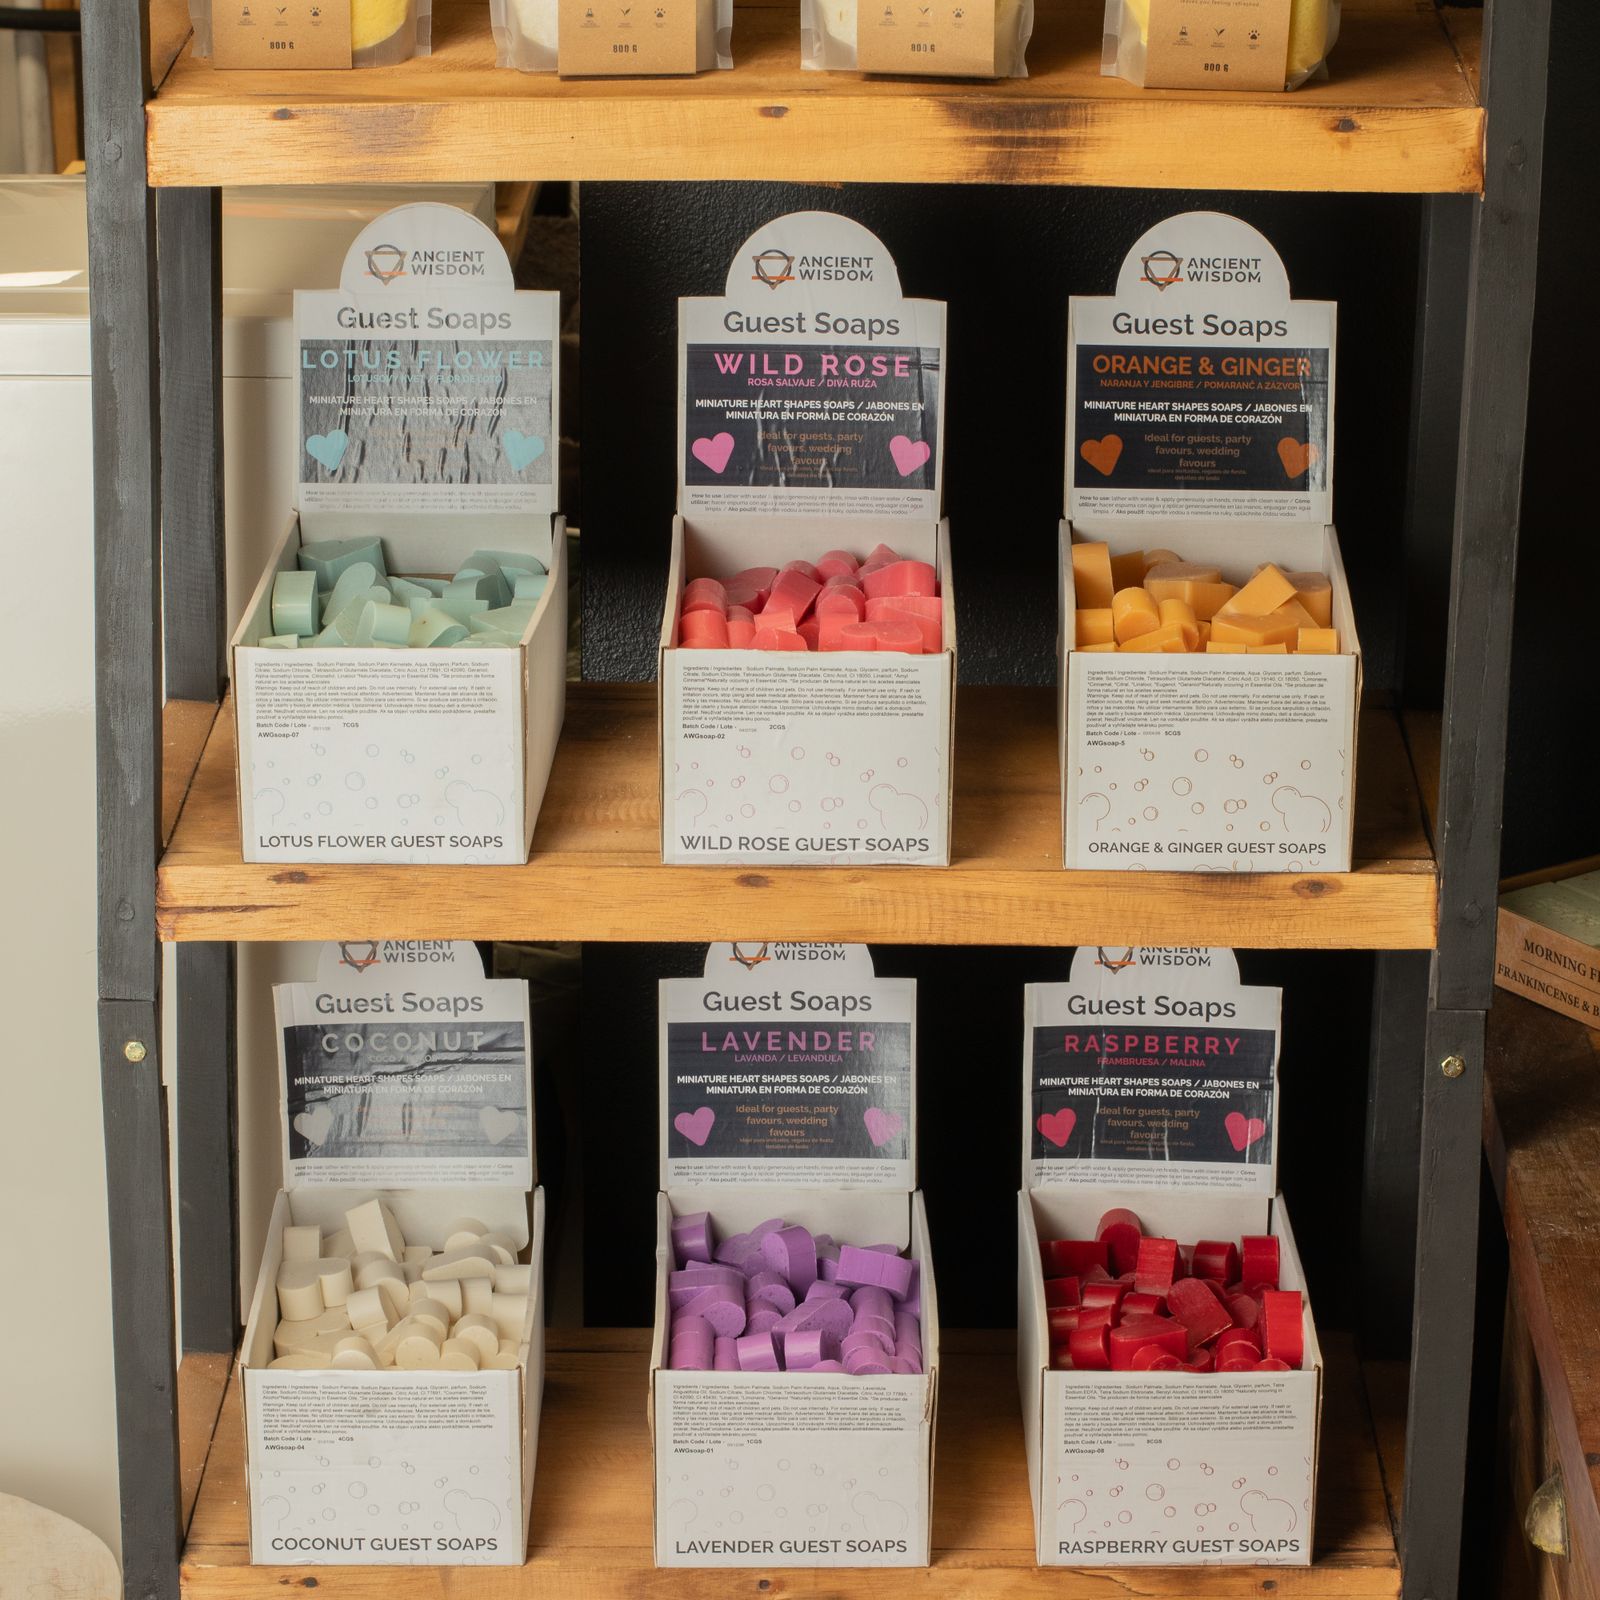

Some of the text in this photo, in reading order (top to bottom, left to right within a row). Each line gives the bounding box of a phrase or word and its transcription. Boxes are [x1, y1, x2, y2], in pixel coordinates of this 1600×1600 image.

[412, 251, 485, 262] ANCIENT
[799, 256, 873, 268] ANCIENT
[412, 264, 485, 276] WISDOM
[1187, 258, 1261, 270] ANCIENT
[799, 269, 873, 282] WISDOM
[1187, 271, 1261, 283] WISDOM
[337, 307, 511, 335] Guest Soaps
[724, 311, 899, 340] Guest Soaps
[1113, 313, 1287, 342] Guest Soaps
[302, 349, 543, 369] LOTUS FLOWER
[714, 353, 910, 377] WILD ROSE
[1092, 354, 1311, 377] ORANGE & GINGER
[748, 378, 773, 386] ROSA
[775, 378, 816, 387] SALVAJE
[1100, 380, 1142, 388] NARANJA
[1150, 380, 1194, 389] JENGIBRE
[696, 399, 925, 411] MINIATURE HEART SHAPES SOAPS JABONES EN
[1084, 401, 1313, 413] MINIATURE HEART SHAPES SOAPS JABONES EN
[726, 410, 894, 422] MINIATURA EN FORMA DE CORAZÓN
[1114, 412, 1282, 424] MINIATURA EN FORMA DE CORAZÓN
[1171, 434, 1186, 443] for
[1188, 434, 1223, 446] guests,
[1225, 435, 1252, 447] party
[1196, 446, 1240, 458] wedding
[1179, 458, 1216, 468] favours
[260, 836, 503, 847] LOTUS FLOWER GUEST SOAPS
[681, 836, 929, 851] WILD ROSE GUEST SOAPS
[1089, 842, 1326, 854] ORANGE & GINGER GUEST SOAPS
[383, 941, 453, 950] ANCIENT
[383, 951, 455, 963] WISDOM
[774, 949, 846, 961] WISDOM
[1140, 955, 1211, 967] WISDOM
[1524, 939, 1586, 976] MORNING
[1498, 963, 1580, 1008] FRANKINCENSE
[1582, 1001, 1590, 1013] &
[1593, 1005, 1600, 1017] B
[316, 992, 483, 1017] Guest Soaps
[703, 991, 871, 1016] Guest Soaps
[1068, 995, 1235, 1022] Guest Soaps
[321, 1032, 485, 1053] COCONUT
[701, 1031, 876, 1052] LAVENDER
[1064, 1035, 1241, 1055] RASPBERRY
[734, 1054, 777, 1062] LAVANDA
[1097, 1058, 1205, 1067] FRAMBRUESA MALINA
[677, 1075, 896, 1084] MINIATURE HEART SHAPES SOAPS JABONES EN
[1040, 1077, 1259, 1089] MINIATURE HEART SHAPES SOAPS JABONES EN
[706, 1084, 868, 1094] MINIATURA EN FORMA DE CORAZÓN
[1068, 1088, 1230, 1099] MINIATURA EN FORMA DE CORAZÓN
[272, 1538, 497, 1550] COCONUT GUEST SOAPS
[676, 1540, 907, 1553] LAVENDER GUEST SOAPS
[1059, 1539, 1299, 1554] RASPBERRY GUEST SOAPS
